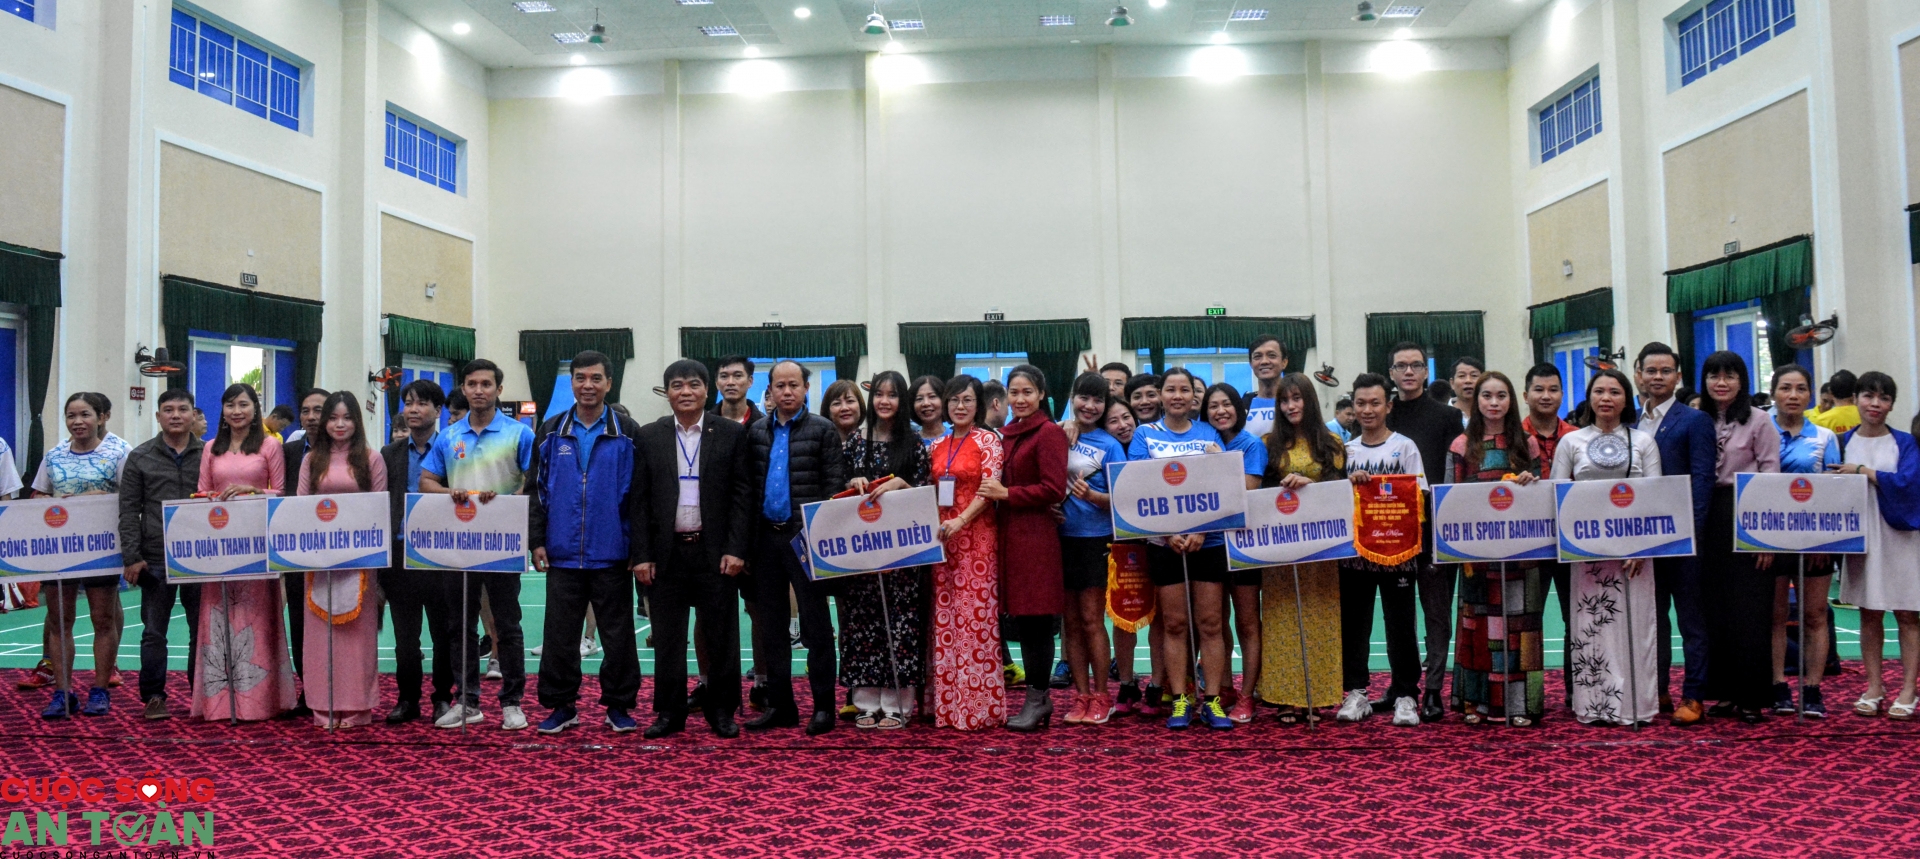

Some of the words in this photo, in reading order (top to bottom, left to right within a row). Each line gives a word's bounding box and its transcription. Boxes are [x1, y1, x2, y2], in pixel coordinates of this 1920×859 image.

[1070, 443, 1097, 459] ONEX
[1171, 442, 1206, 454] YONEX
[1137, 497, 1169, 517] CLB
[1174, 492, 1220, 514] TUSU
[1235, 529, 1255, 549] CLB
[1271, 522, 1300, 545] HÀNH
[1301, 518, 1348, 542] FIDITOUR
[1442, 523, 1459, 542] CLB
[1462, 522, 1474, 541] HL
[1476, 521, 1506, 541] SPORT
[1508, 518, 1556, 539] BADMINTO
[1574, 520, 1600, 540] CLB
[1604, 515, 1676, 538] SUNBATTA
[1742, 511, 1759, 531] CLB
[1761, 508, 1785, 531] CÔNG
[1819, 511, 1842, 535] NGỌC
[0, 537, 28, 558] CÔNG
[31, 535, 59, 556] ĐOÀN
[61, 532, 85, 553] VIÊN
[87, 530, 115, 552] CHỨC
[171, 540, 193, 559] LĐLĐ
[195, 536, 219, 560] QUẬN
[220, 536, 251, 556] THANH
[253, 535, 266, 554] KH
[272, 533, 297, 552] LĐLĐ
[299, 529, 326, 554] QUẬN
[329, 528, 350, 550] LIÊN
[410, 528, 432, 549] CÔNG
[434, 528, 455, 550] ĐOÀN
[456, 529, 482, 551] NGÀNH
[484, 530, 502, 551] GIÁO
[504, 533, 521, 555] DỤC
[818, 537, 848, 558] CLB
[851, 530, 893, 553] CÁNH
[896, 520, 932, 547] DIỀU
